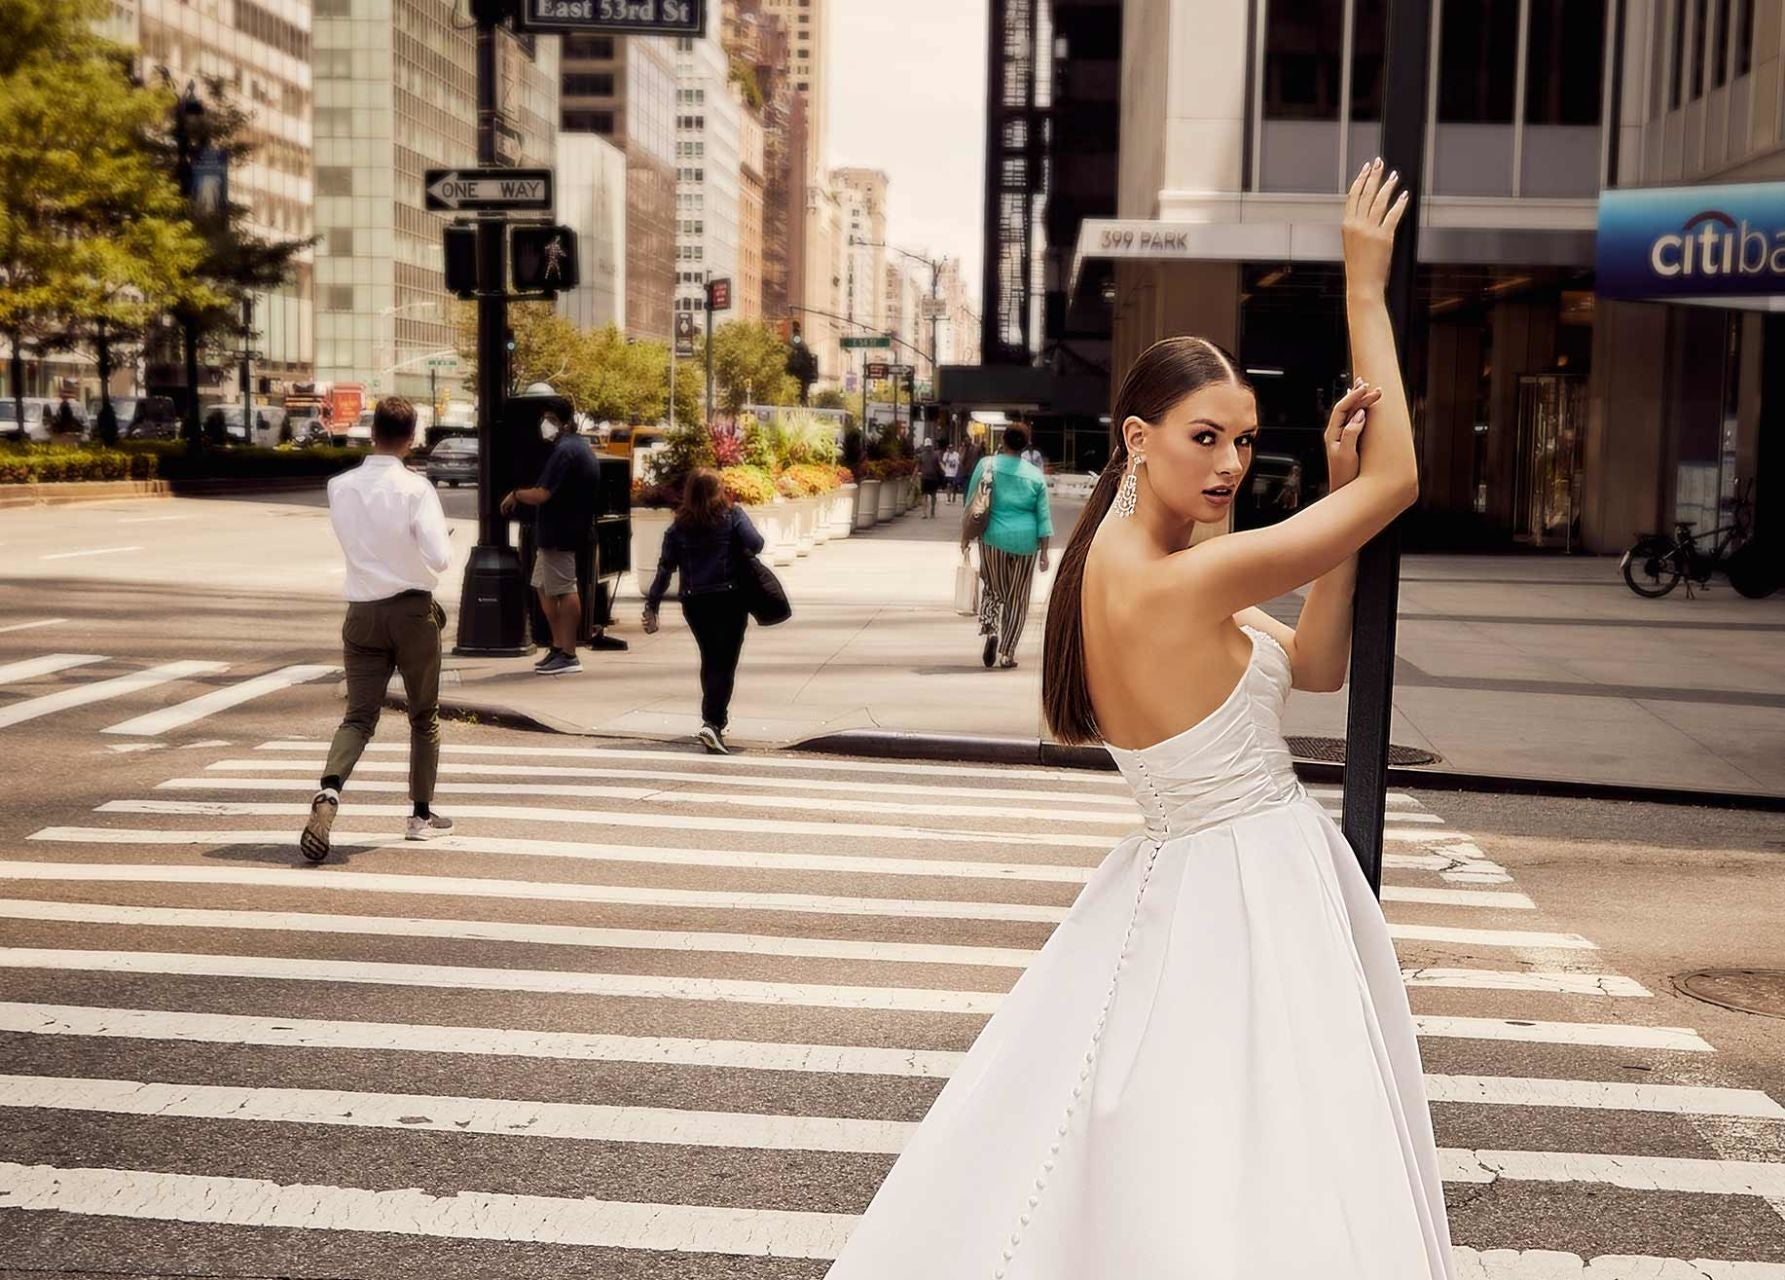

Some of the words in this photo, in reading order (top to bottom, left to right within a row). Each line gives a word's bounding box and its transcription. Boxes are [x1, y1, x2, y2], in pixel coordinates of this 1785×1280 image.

[536, 0, 592, 18] East
[600, 0, 654, 20] 53rd
[662, 0, 689, 22] St
[441, 182, 479, 198] ONE
[500, 182, 540, 198] WAY
[1101, 231, 1134, 249] 399
[1141, 231, 1188, 251] PARK
